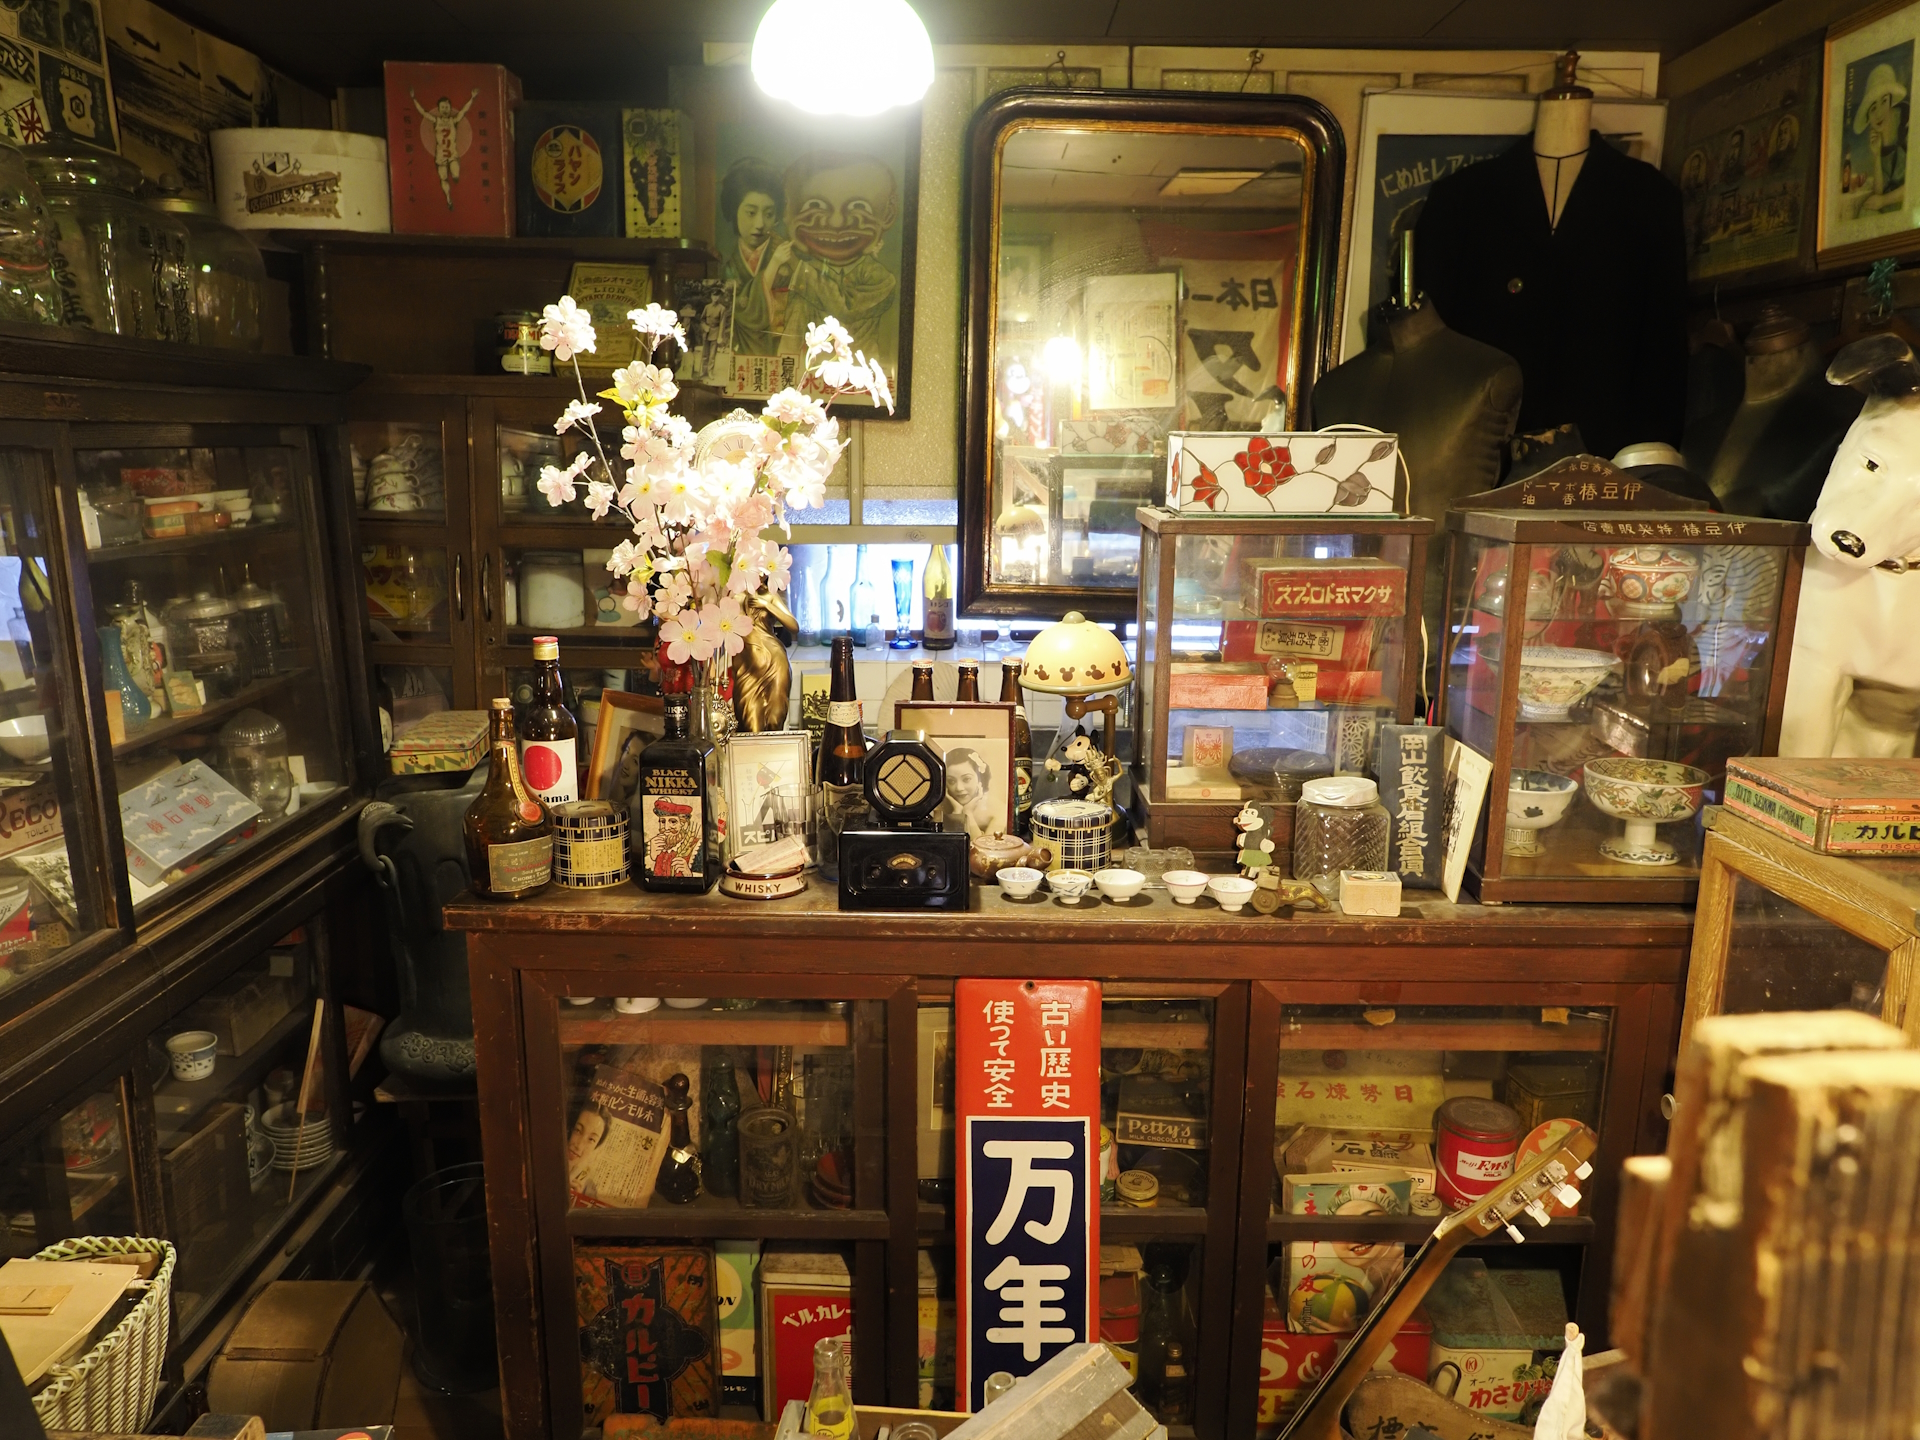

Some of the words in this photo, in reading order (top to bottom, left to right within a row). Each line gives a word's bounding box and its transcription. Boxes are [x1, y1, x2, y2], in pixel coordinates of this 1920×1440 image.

[441, 128, 452, 159] グリコ
[568, 145, 582, 186] ハヤシ
[554, 159, 567, 195] ライス
[1579, 482, 1644, 501] 伊豆椿
[652, 768, 689, 777] BLACK
[645, 776, 698, 789] NIKKA
[649, 788, 695, 796] WHISKY
[25, 823, 55, 839] TOILET
[735, 881, 781, 894] WHISKY
[983, 999, 1015, 1109] 使って安全
[1040, 1000, 1072, 1109] 古い歴史
[1128, 1119, 1191, 1139] Petty's
[1129, 1133, 1145, 1142] MILK
[1147, 1135, 1187, 1144] CHOCOLATE
[982, 1140, 1076, 1362] 万年
